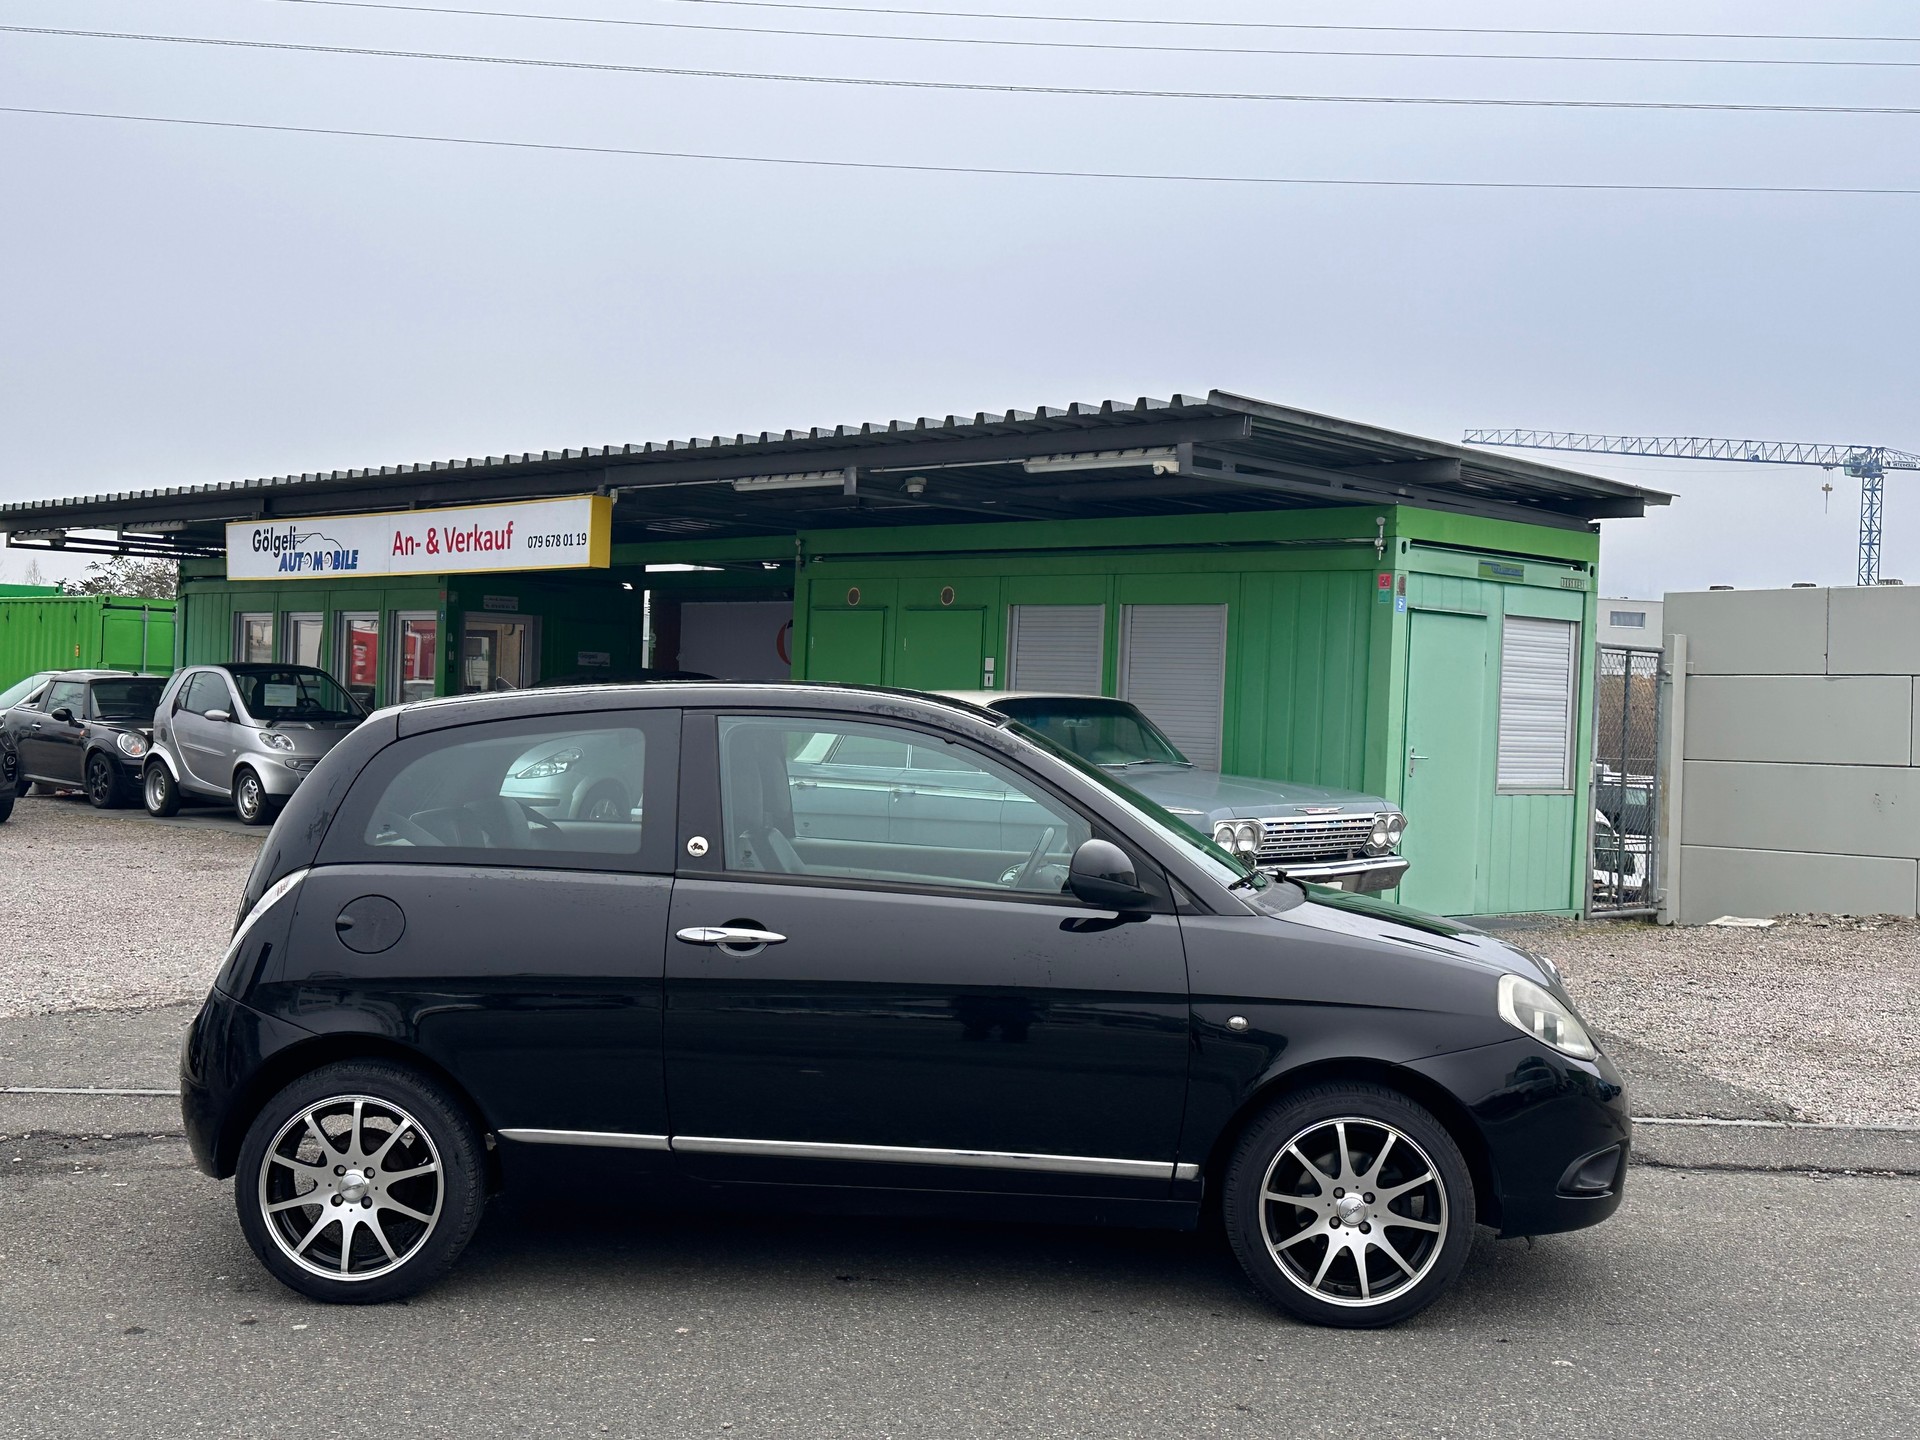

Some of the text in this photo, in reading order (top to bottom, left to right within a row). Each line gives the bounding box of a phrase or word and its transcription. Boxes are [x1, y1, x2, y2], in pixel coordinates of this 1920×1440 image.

[252, 526, 296, 558] Gölgeli
[392, 521, 514, 556] An- & Verkauf
[527, 532, 587, 549] 079 678 01 19
